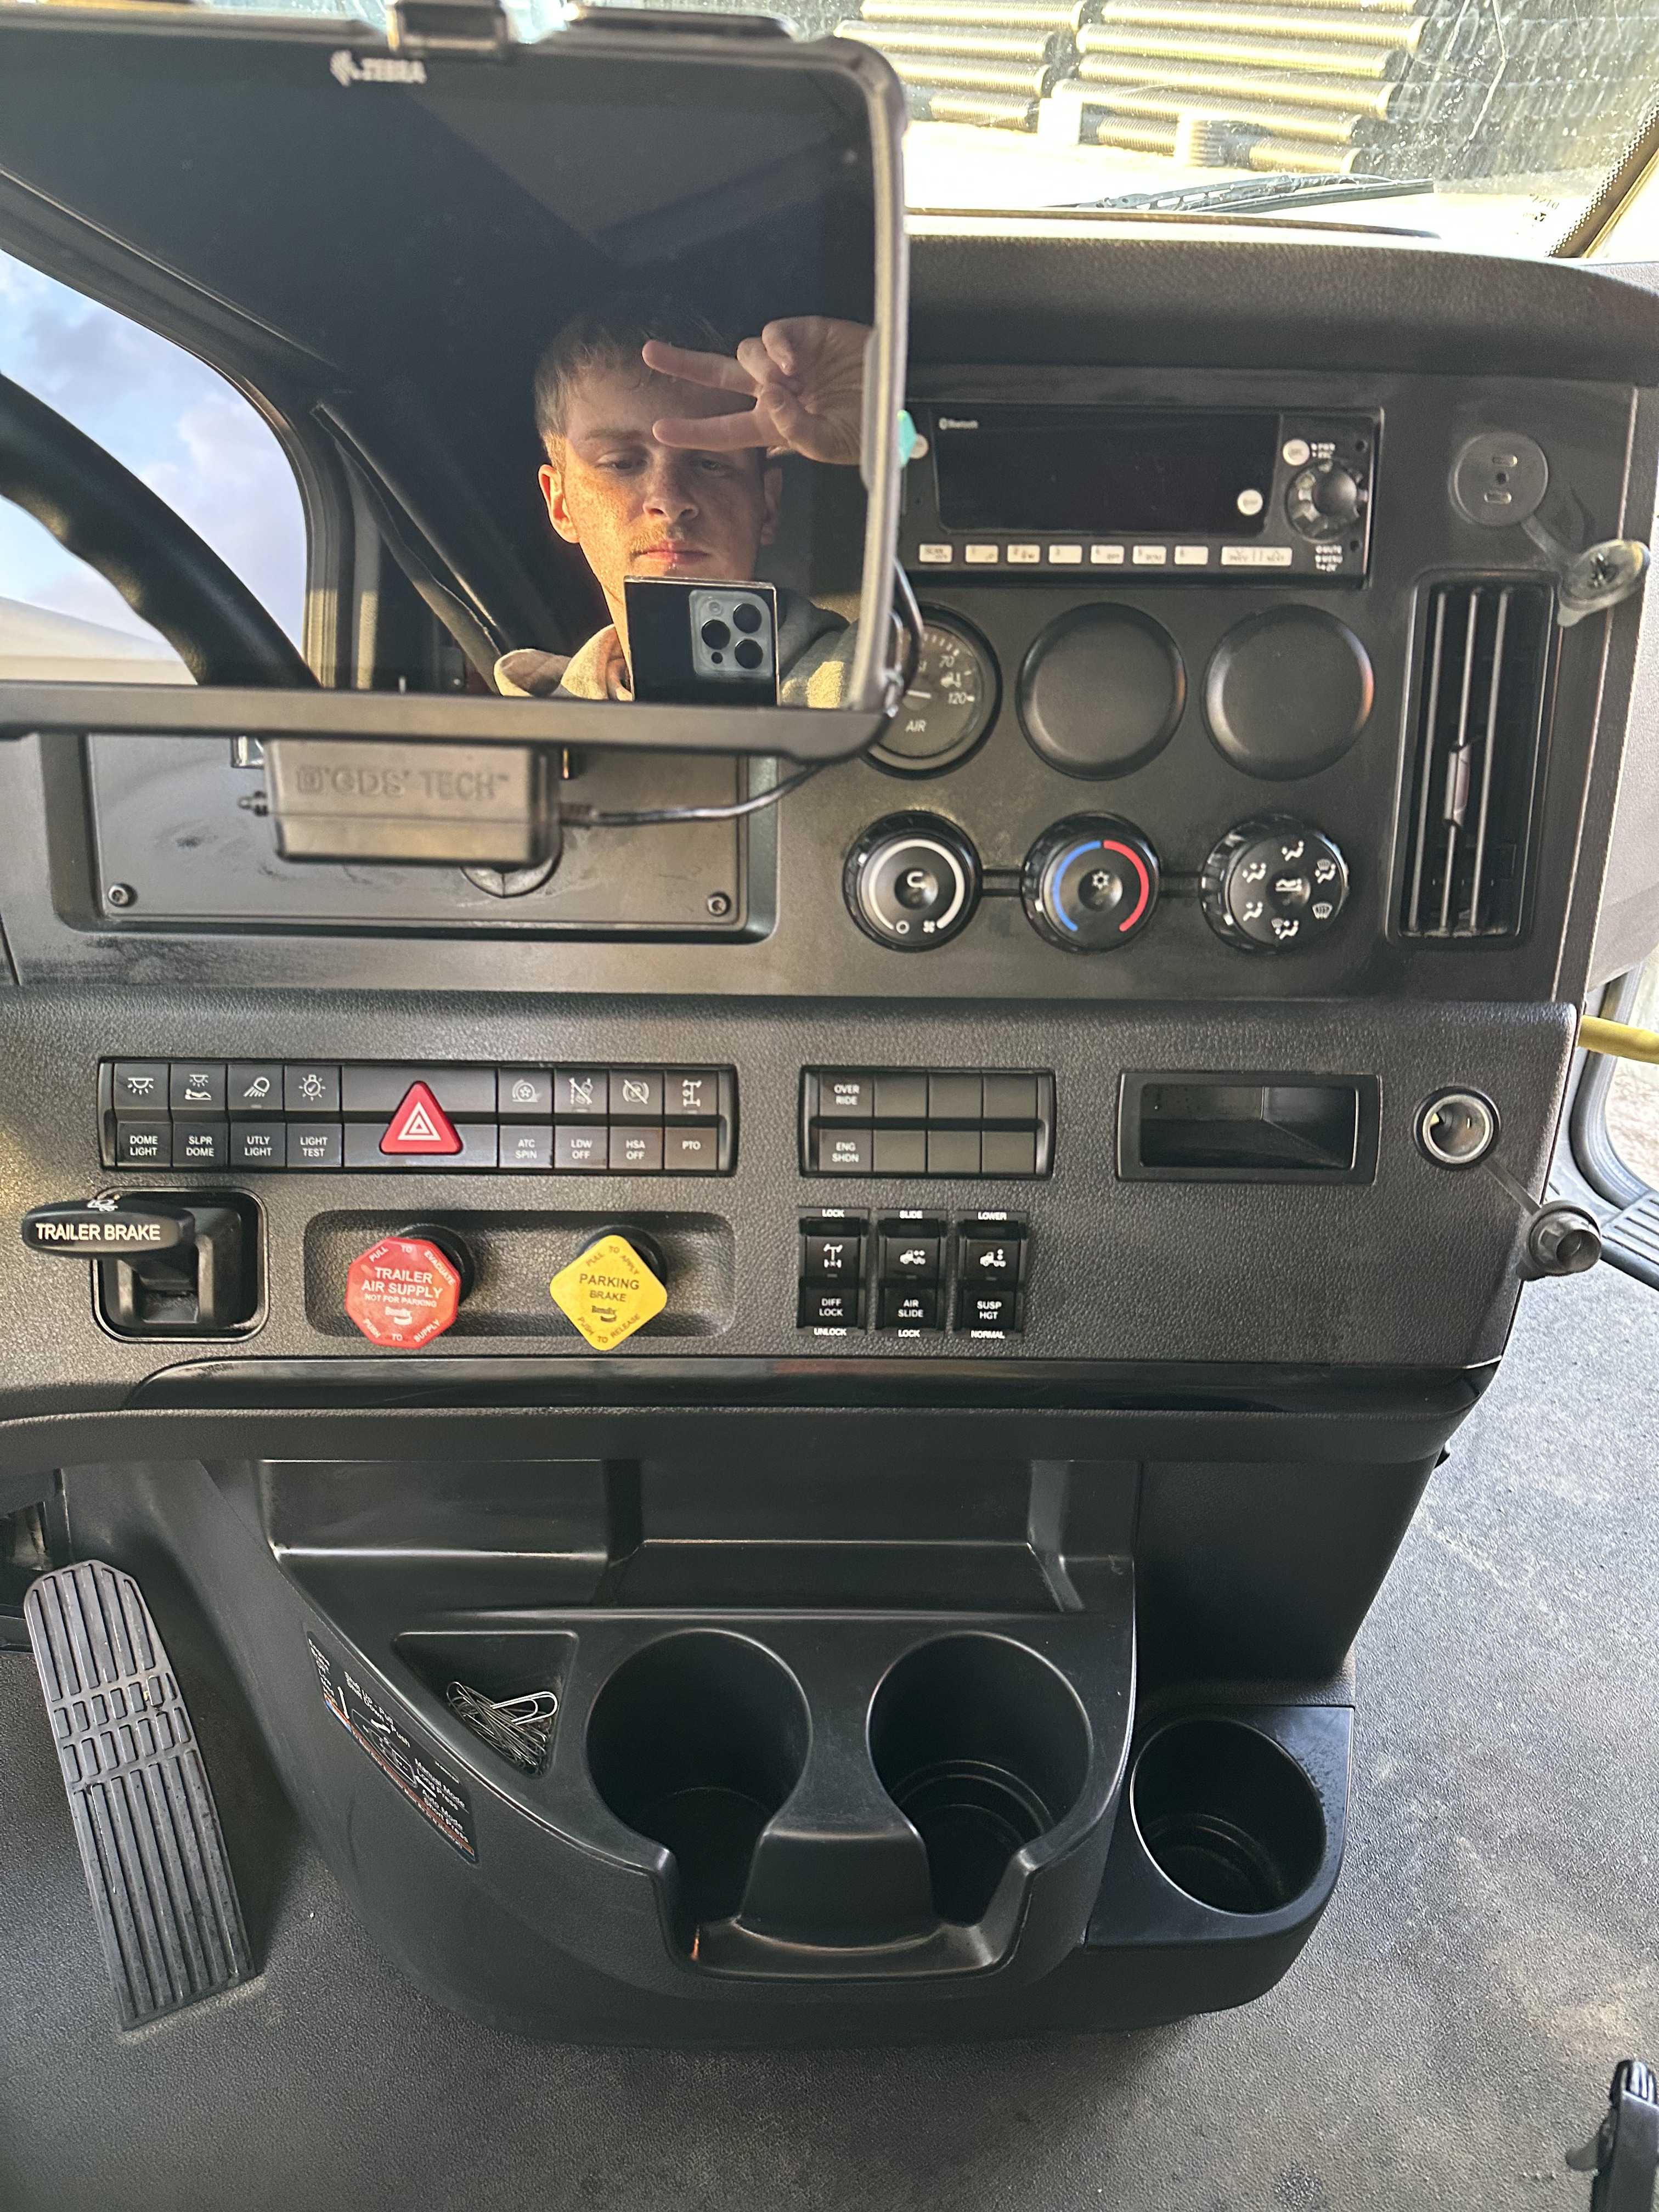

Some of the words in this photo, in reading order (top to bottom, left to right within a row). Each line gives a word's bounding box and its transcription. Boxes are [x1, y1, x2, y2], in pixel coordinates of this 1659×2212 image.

[949, 692, 965, 704] 120
[906, 721, 926, 732] AIR
[834, 1085, 859, 1094] OVER
[836, 1096, 857, 1105] RIDE
[129, 1135, 158, 1145] DOME
[188, 1135, 213, 1146] SLPR
[246, 1136, 270, 1146] UTLY
[300, 1137, 328, 1147] LIGHT
[518, 1139, 535, 1148] ATC
[682, 1141, 700, 1150] PTO
[836, 1142, 855, 1152] ENG
[129, 1146, 157, 1156] LIGHT
[186, 1146, 215, 1157] DOME
[244, 1146, 273, 1157] LIGHT
[302, 1147, 325, 1157] TEST
[572, 1150, 590, 1160] OFF
[626, 1150, 645, 1160] OFF
[36, 1223, 101, 1240] TRAILER
[104, 1224, 160, 1240] BRAKE
[369, 1246, 388, 1262] PULL
[424, 1251, 455, 1285] EVACUATE
[375, 1267, 432, 1284] TRAILER
[579, 1274, 639, 1290] PARKING
[362, 1279, 384, 1293] AIR
[388, 1283, 443, 1299] SUPPLY
[590, 1290, 627, 1302] BRAKE
[402, 1298, 437, 1307] PARKING
[980, 1311, 998, 1319] HGT
[363, 1319, 381, 1338] PUSH
[414, 1319, 440, 1342] SUPPLY
[610, 1314, 640, 1339] RELEASE
